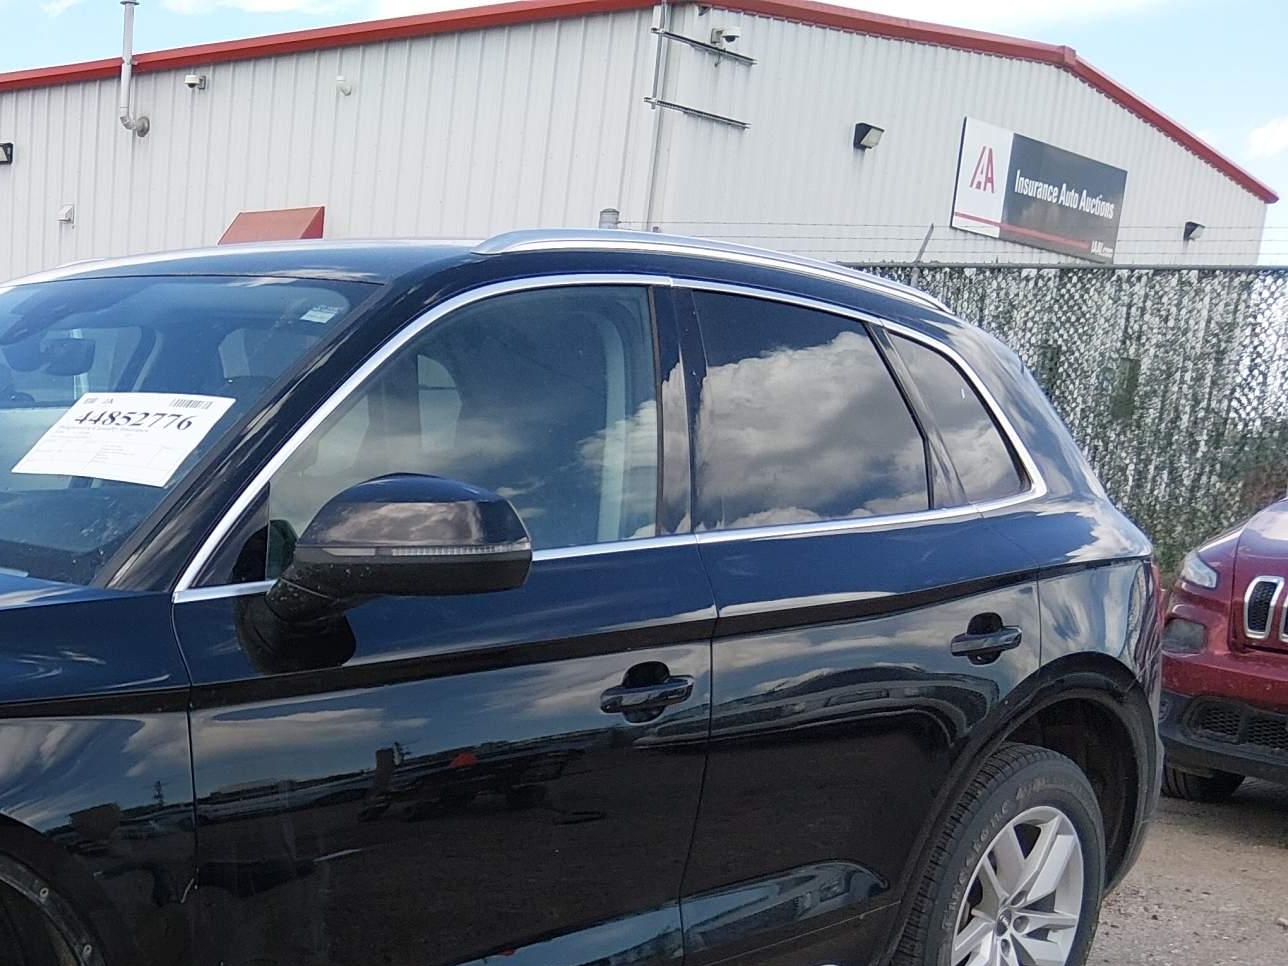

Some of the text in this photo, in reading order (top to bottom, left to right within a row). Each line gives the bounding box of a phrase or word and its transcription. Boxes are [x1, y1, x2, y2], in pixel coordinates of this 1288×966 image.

[1014, 169, 1115, 220] Insurance Auto Auctions
[74, 409, 197, 431] 44852776
